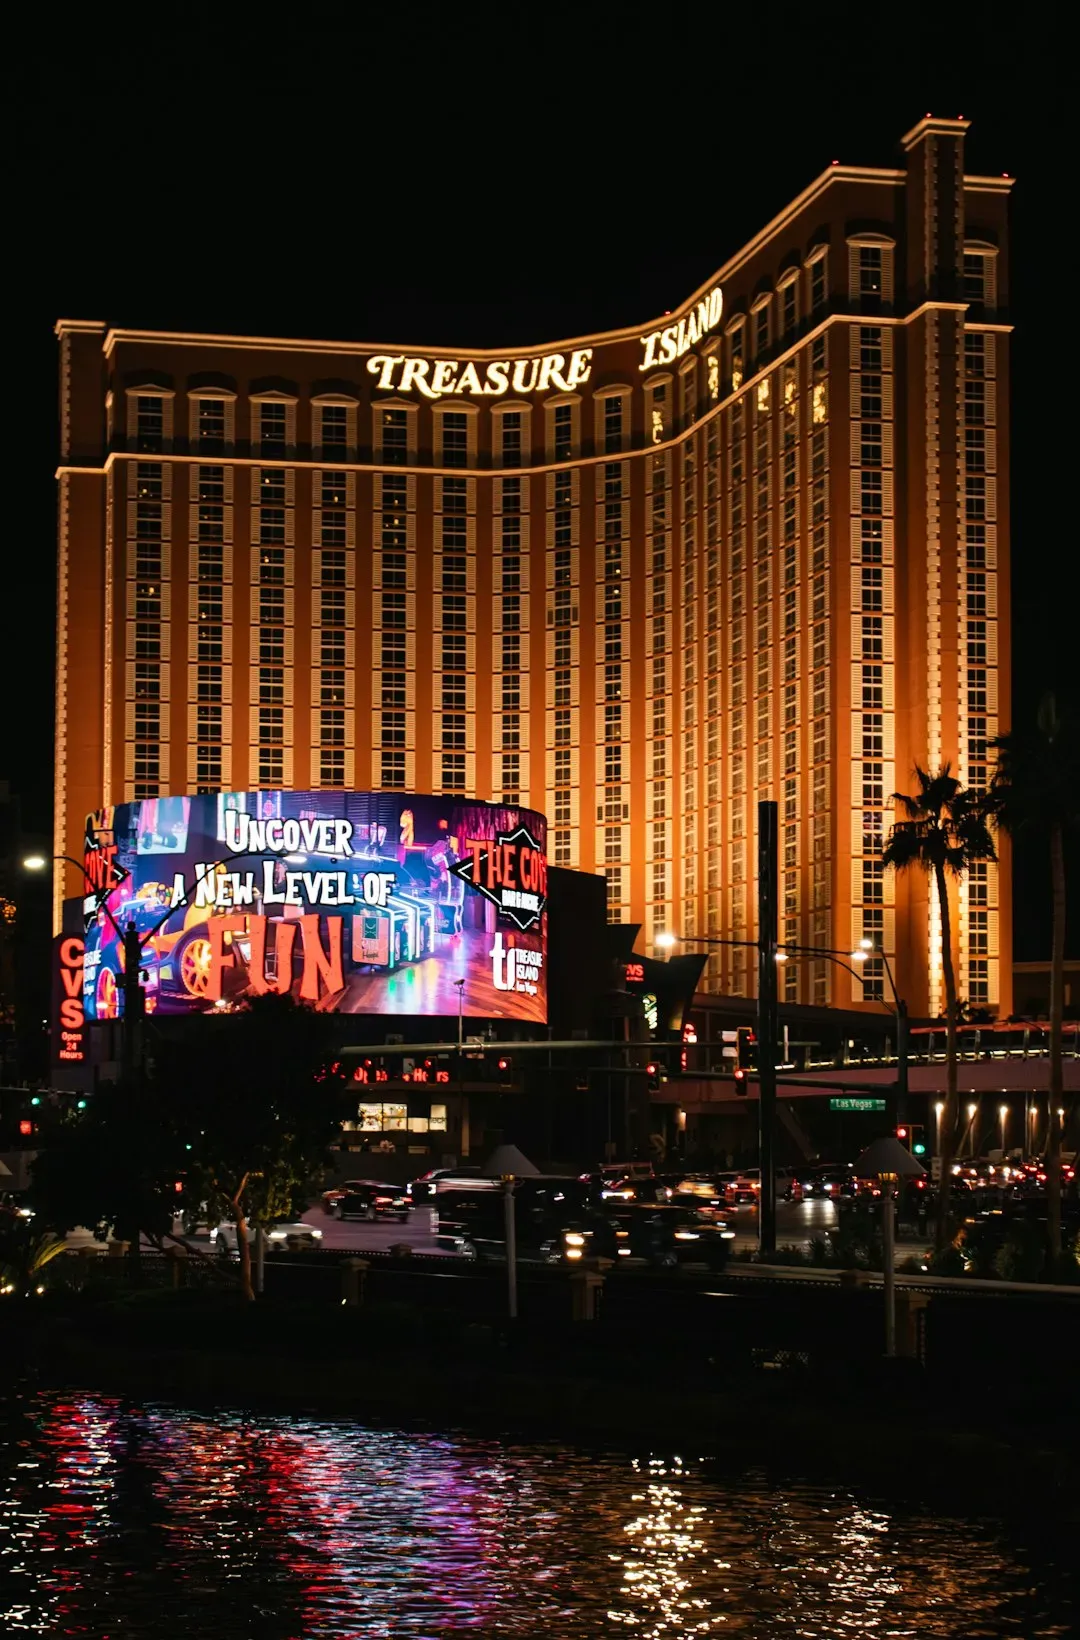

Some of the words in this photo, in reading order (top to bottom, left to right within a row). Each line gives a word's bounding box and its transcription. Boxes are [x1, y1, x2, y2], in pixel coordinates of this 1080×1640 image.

[366, 348, 593, 399] TREASURE
[638, 287, 724, 372] ISLAND
[224, 809, 353, 856] UNCOVER
[169, 873, 188, 909] A
[194, 862, 255, 908] NEW
[262, 860, 354, 907] LEVEL
[363, 872, 395, 907] OF
[465, 838, 517, 889] THE
[207, 912, 345, 1001] FUN
[60, 938, 85, 1029] CVS
[60, 1050, 83, 1060] Hours
[61, 1031, 82, 1041] Open
[66, 1042, 77, 1051] 24
[354, 1067, 388, 1084] Opn
[413, 1067, 449, 1082] Hors
[835, 1098, 849, 1108] Las
[850, 1098, 873, 1110] Vegas
